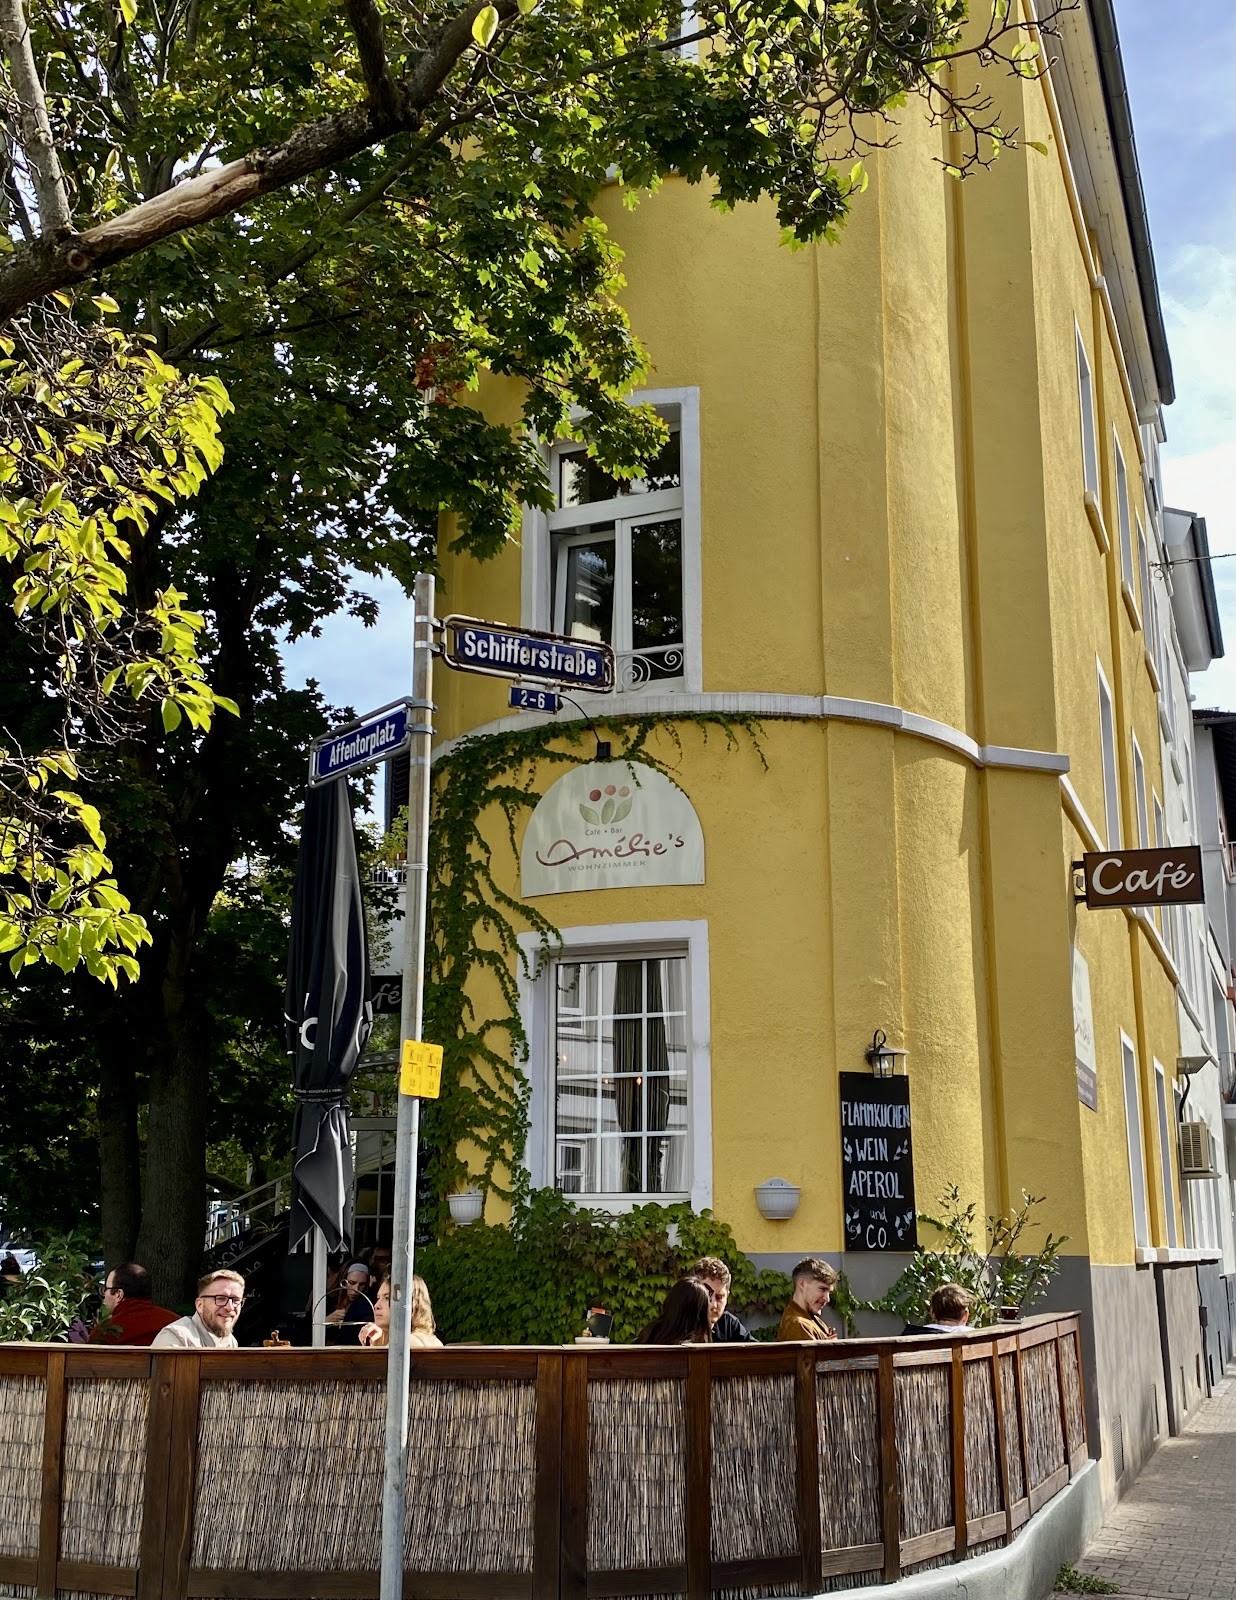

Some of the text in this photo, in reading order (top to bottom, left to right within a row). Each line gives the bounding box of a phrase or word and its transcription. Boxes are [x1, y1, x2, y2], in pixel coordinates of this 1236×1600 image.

[464, 630, 597, 676] Schifferstraße
[520, 689, 546, 709] 2-6
[328, 720, 396, 768] Affentorplatz
[535, 833, 685, 867] Amélie's
[568, 860, 647, 872] WOHNZIMMER
[1092, 858, 1195, 896] Café
[855, 1137, 889, 1162] WEIN
[849, 1170, 905, 1199] APEROL
[870, 1206, 888, 1223] und
